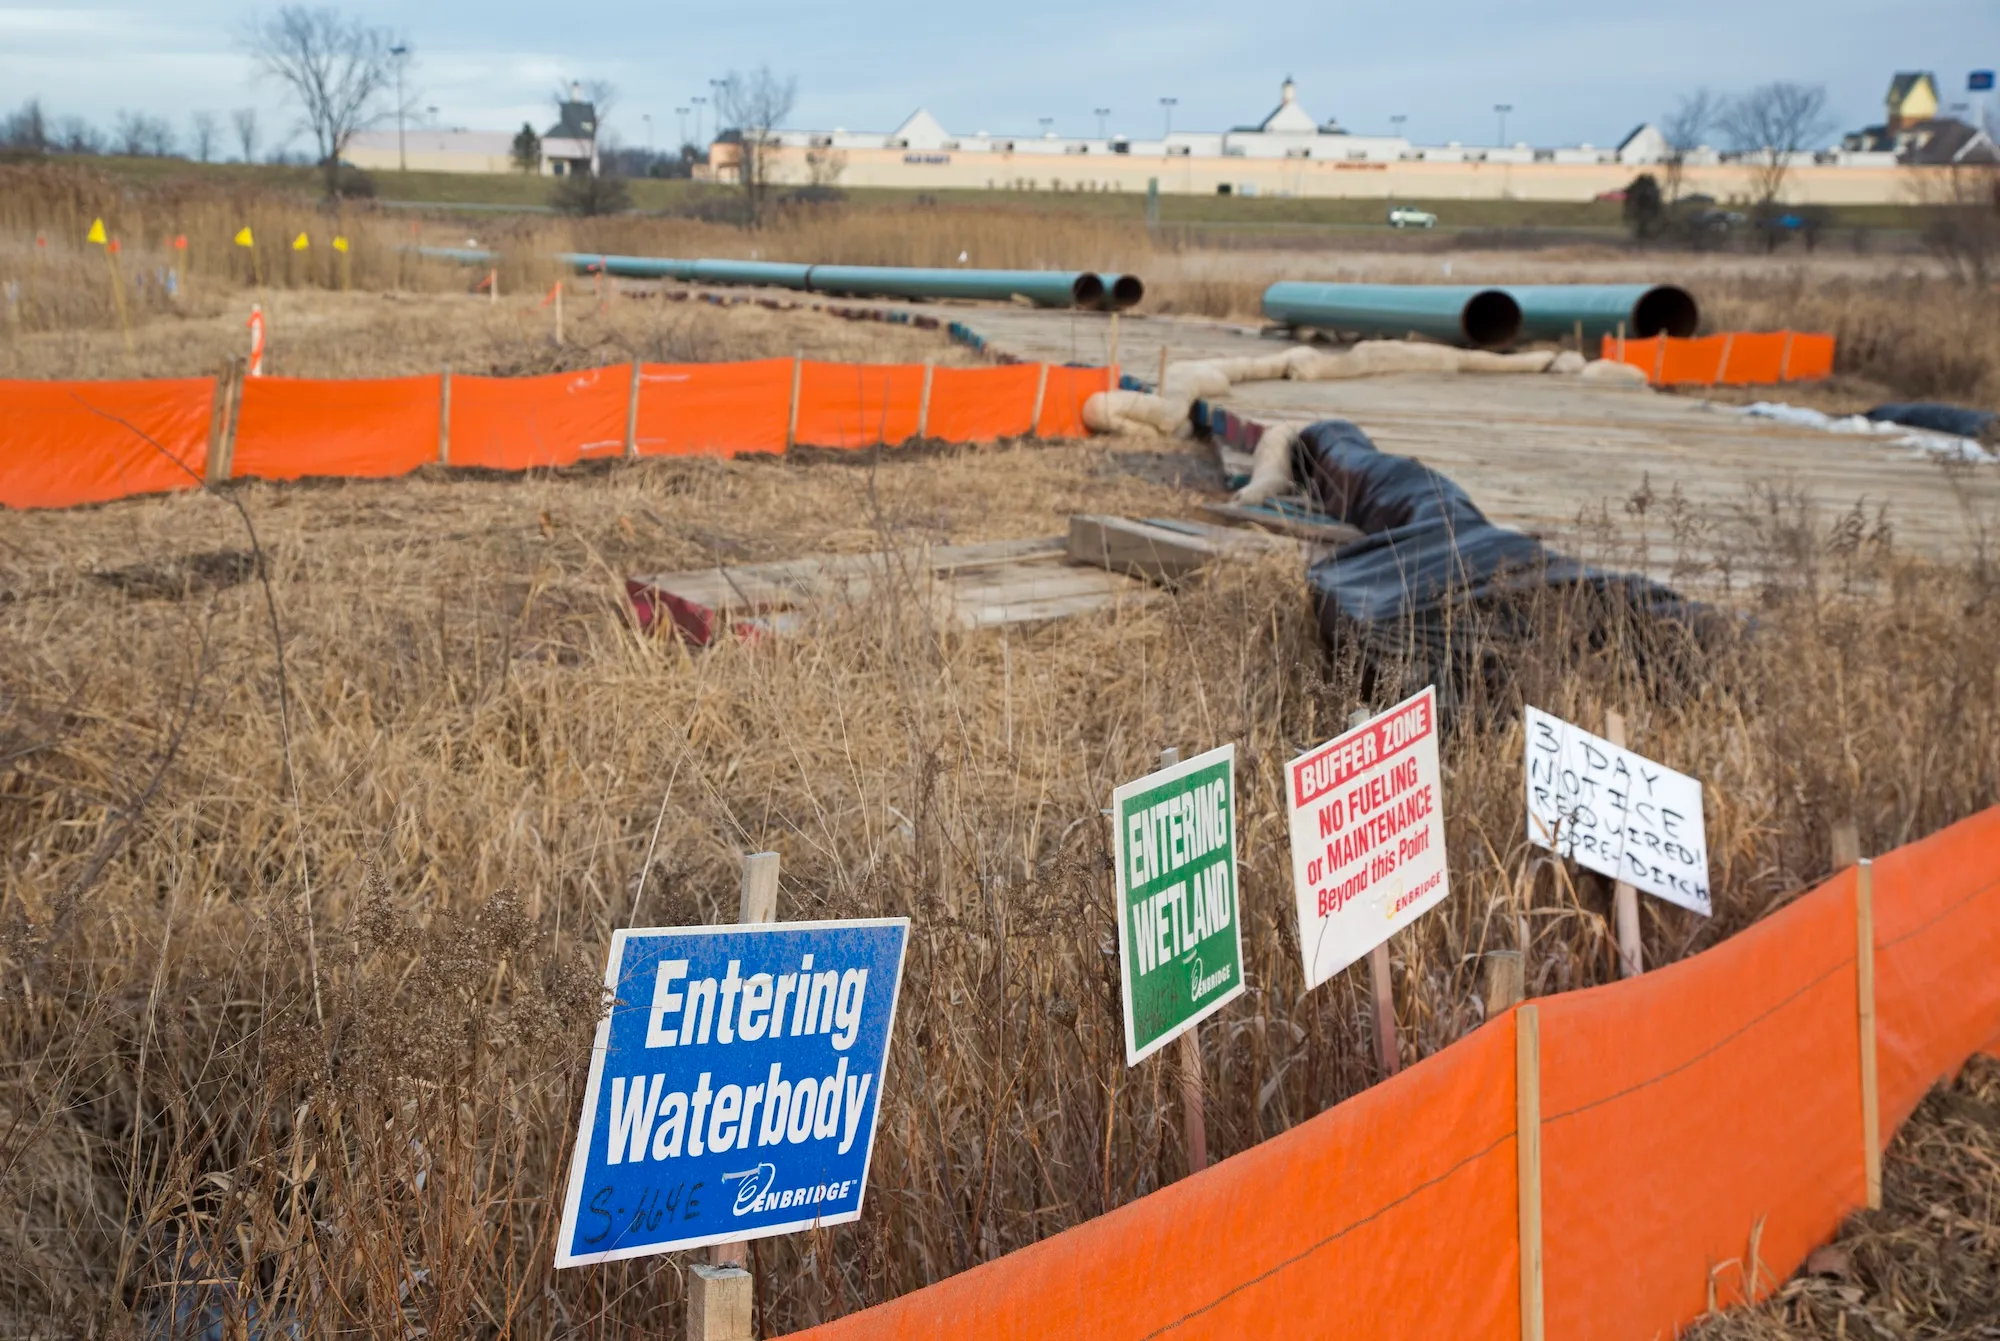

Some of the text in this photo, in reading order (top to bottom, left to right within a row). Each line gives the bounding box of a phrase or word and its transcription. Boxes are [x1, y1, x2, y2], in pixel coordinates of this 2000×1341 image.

[1301, 703, 1427, 800] BUFFER ZONE
[1319, 756, 1418, 839] NO FUELING
[1532, 758, 1685, 839] NOTICE
[1535, 721, 1659, 796] 3 DAY
[1128, 777, 1227, 889] ENTERING
[1307, 784, 1433, 886] or MAINTENANCE
[1318, 824, 1429, 918] Beyond this Point
[1132, 860, 1231, 976] WETLAND
[1395, 871, 1441, 912] ENBRIDGE
[644, 953, 868, 1051] Entering
[1197, 964, 1231, 998] ENBRIDGE
[606, 1056, 873, 1166] Waterbody
[752, 1180, 851, 1213] ENBRIDGE
